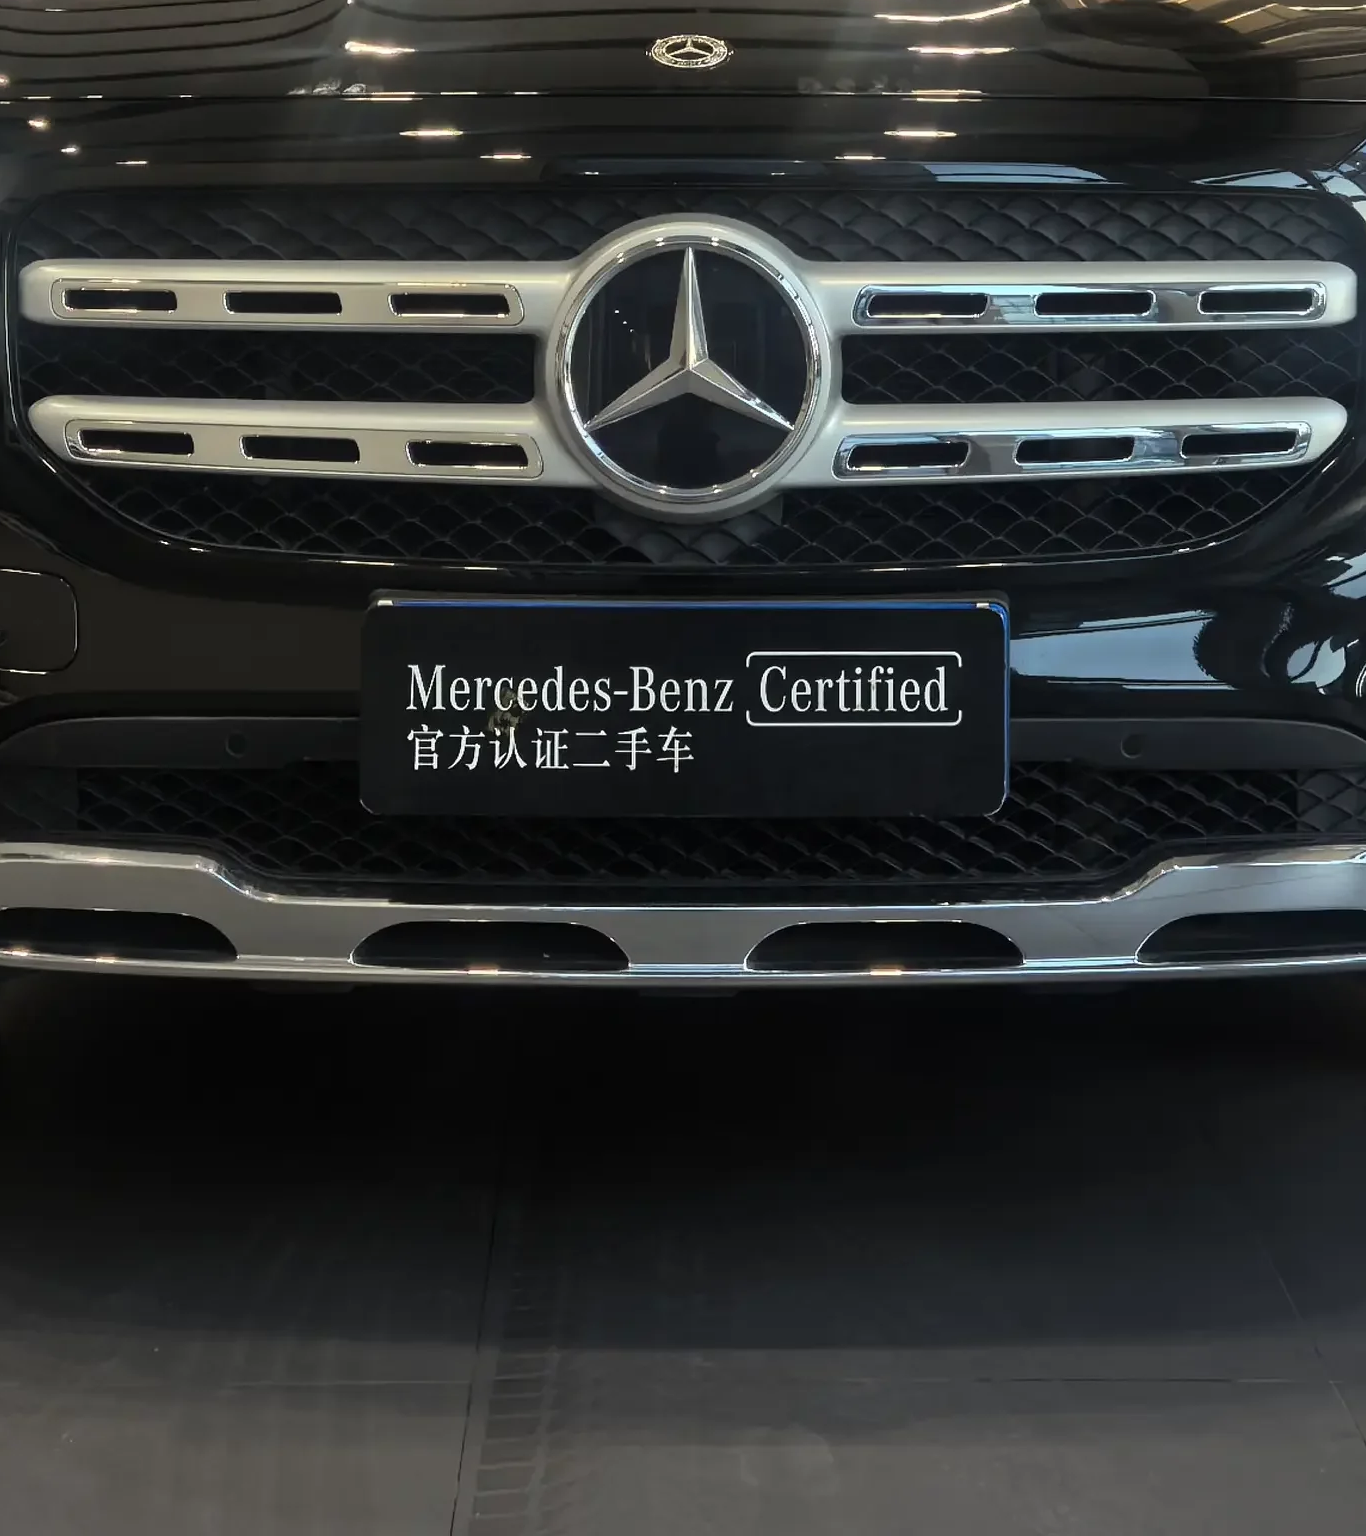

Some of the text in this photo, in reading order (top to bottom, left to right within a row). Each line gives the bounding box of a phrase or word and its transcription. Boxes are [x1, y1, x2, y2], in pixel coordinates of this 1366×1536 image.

[406, 664, 949, 714] Mercedes-Benz Certified
[406, 723, 695, 774] 官方认证二手车
